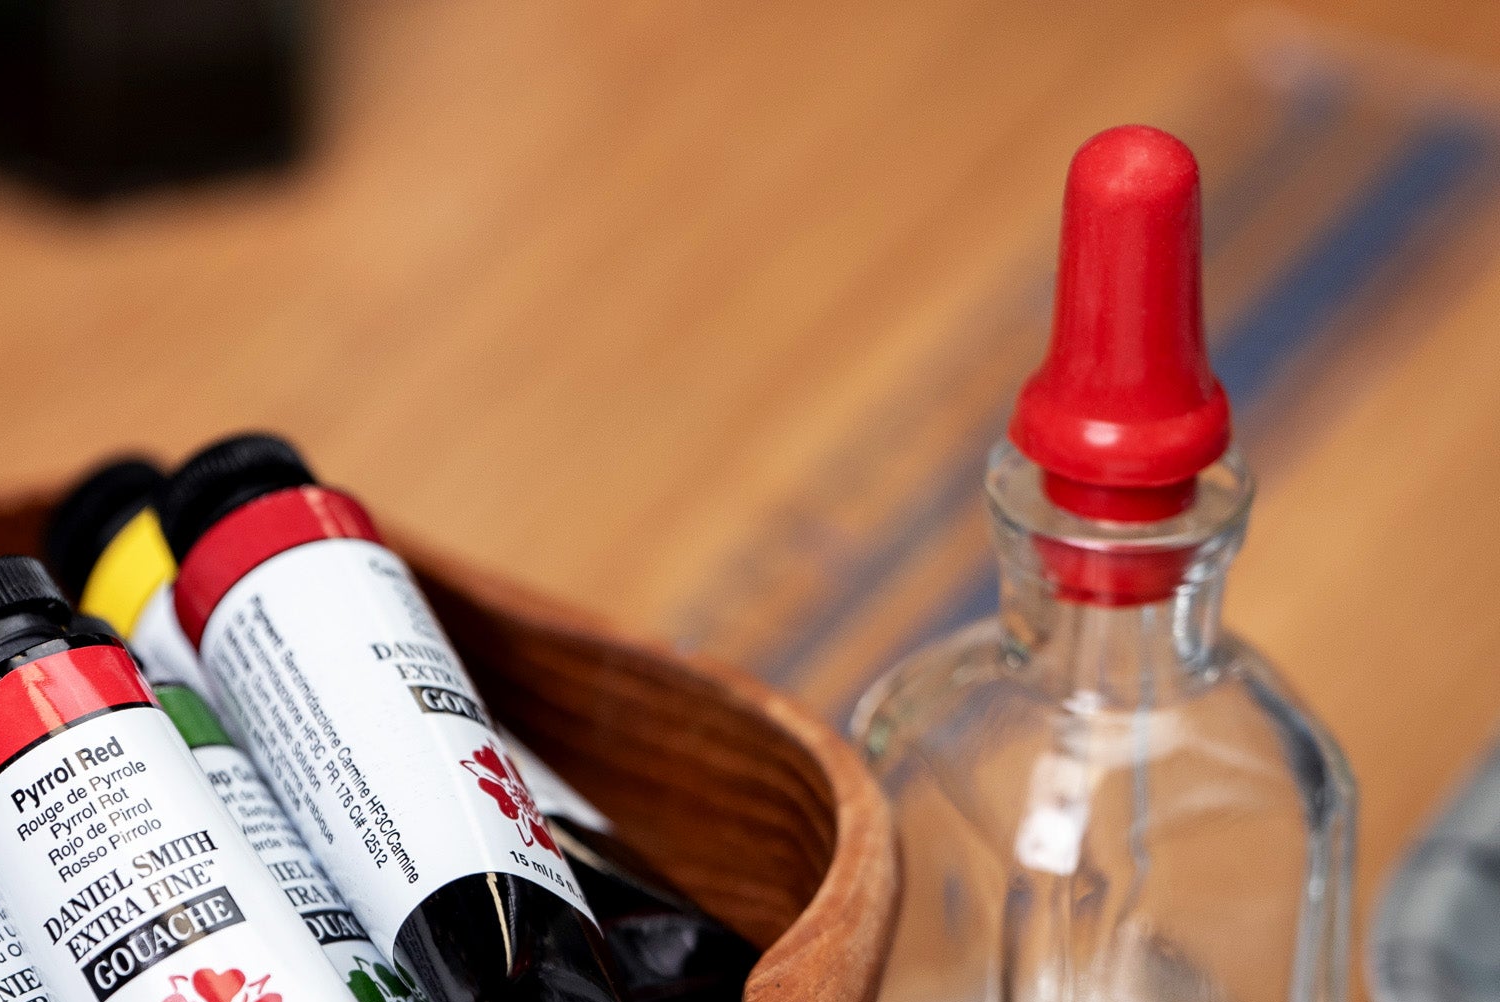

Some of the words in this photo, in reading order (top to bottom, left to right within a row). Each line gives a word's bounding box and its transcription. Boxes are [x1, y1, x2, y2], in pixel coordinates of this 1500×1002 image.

[10, 757, 77, 814] Pyrrol
[75, 735, 125, 771] Red
[16, 800, 65, 842] Rouge
[66, 786, 88, 805] de
[88, 759, 147, 792] Pyrrole
[292, 741, 321, 793] Solution
[300, 723, 326, 760] HF3C
[323, 760, 340, 785] PR
[336, 782, 354, 809] 176
[362, 828, 388, 869] 12512
[47, 836, 84, 867] Rojo
[86, 822, 108, 840] de
[108, 797, 153, 828] Pirrol
[49, 801, 98, 840] Pyrrol
[97, 786, 130, 810] Rot
[303, 792, 335, 845] arabique
[337, 746, 370, 799] Carmine
[365, 795, 419, 884] HF3C/Carmine
[57, 845, 108, 884] Rosso
[108, 818, 162, 850] Pirrolo
[509, 850, 529, 867] 15
[43, 868, 134, 946] DANIEL
[132, 830, 219, 880] SMITH
[64, 896, 146, 964] EXTRA
[93, 895, 234, 991] GOUACHE
